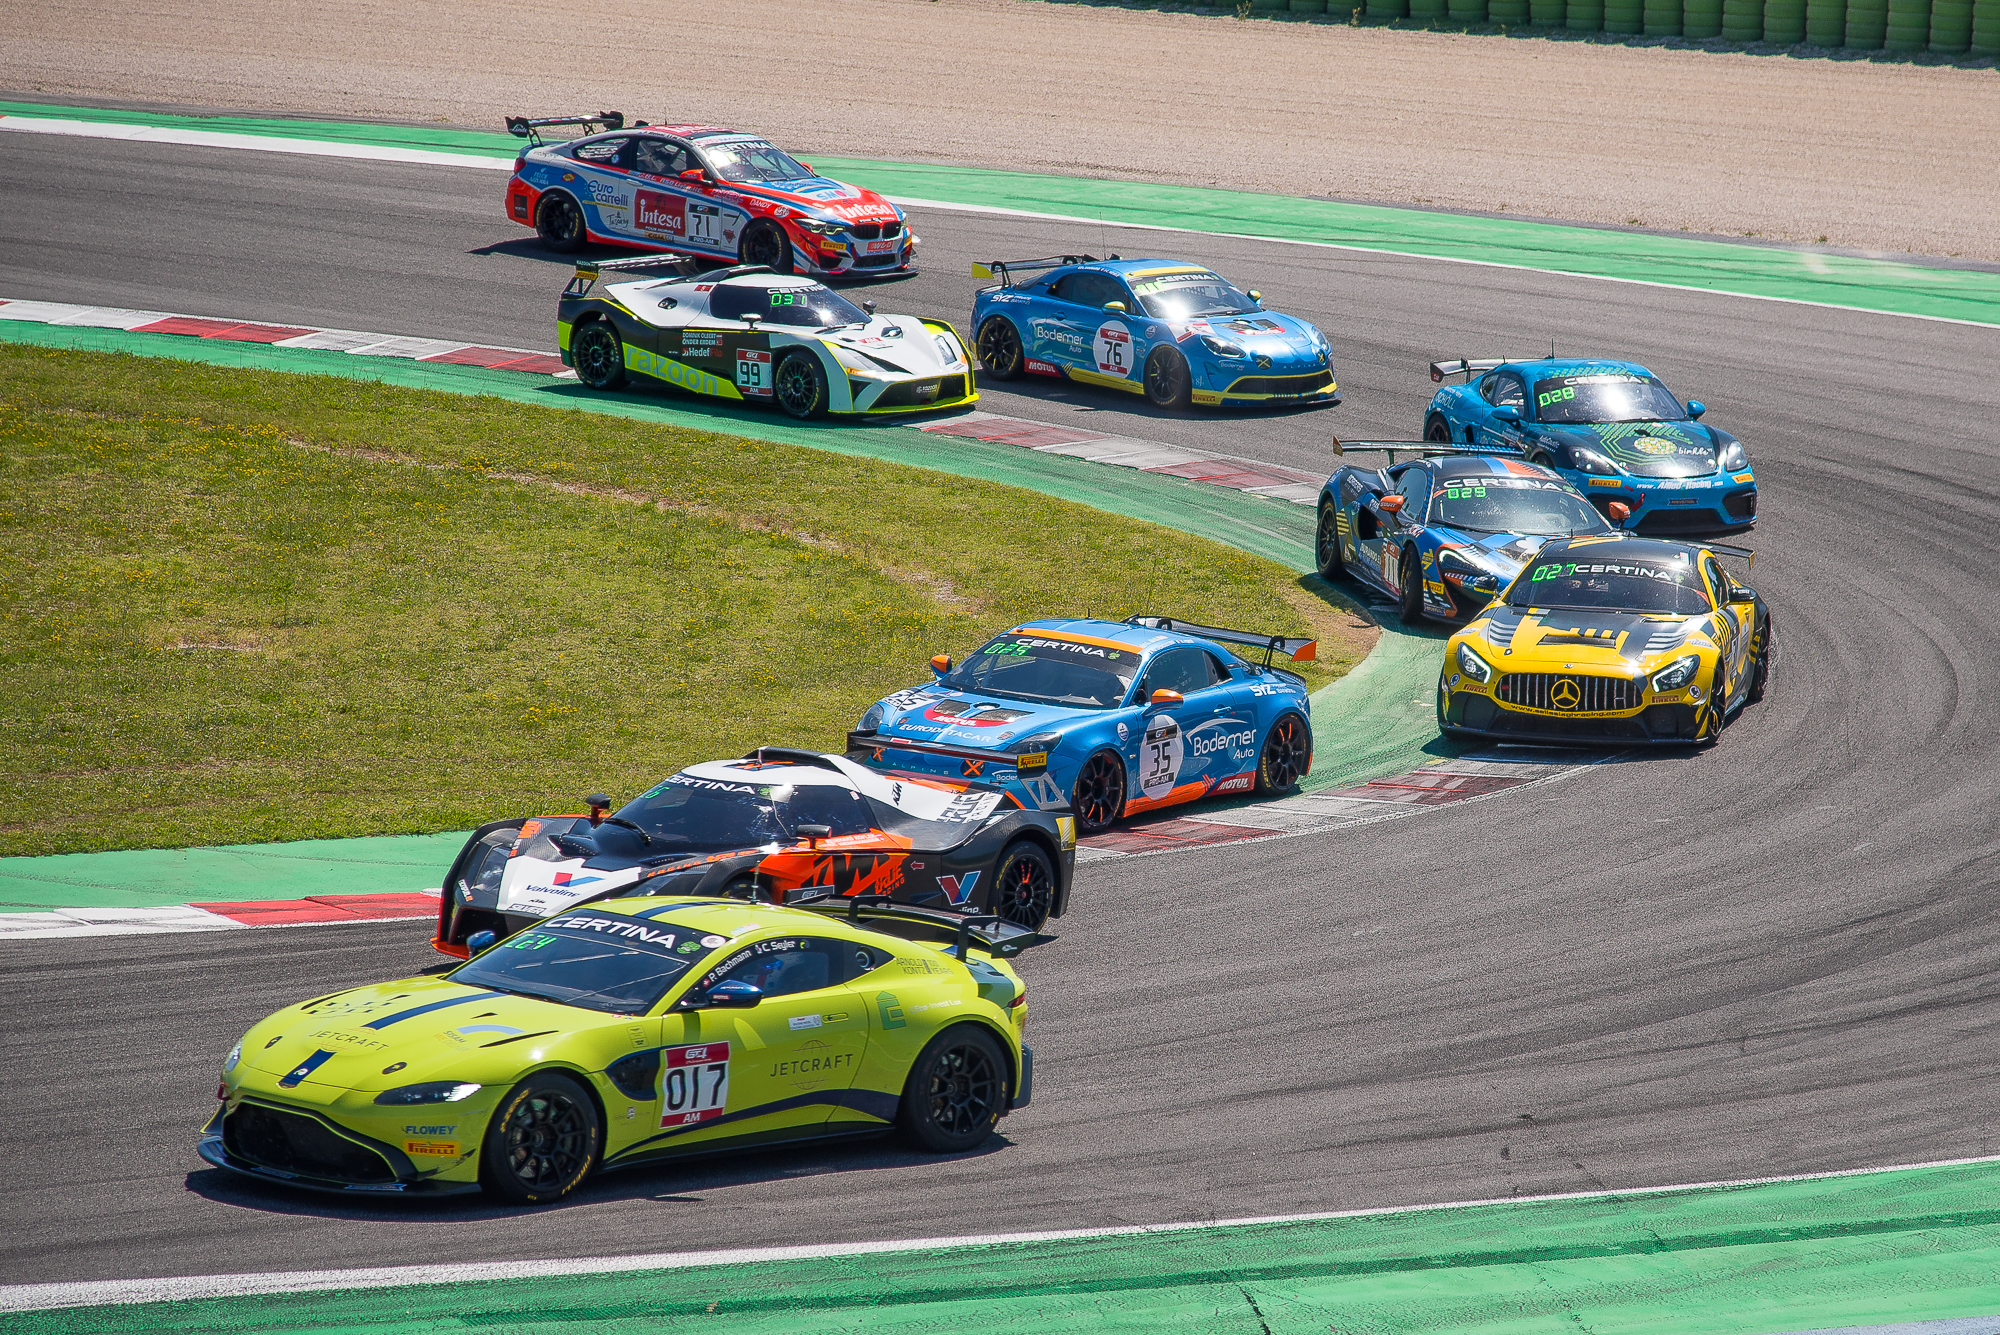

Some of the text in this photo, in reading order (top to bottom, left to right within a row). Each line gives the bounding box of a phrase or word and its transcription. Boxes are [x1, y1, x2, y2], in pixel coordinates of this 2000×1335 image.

[595, 192, 629, 207] carrelli
[749, 198, 772, 209] DANDY
[692, 214, 711, 237] 71
[1156, 274, 1214, 284] CERTINA
[1037, 326, 1084, 346] Bodemer
[1104, 341, 1122, 366] 76
[626, 345, 718, 396] razoon
[739, 361, 761, 386] 99
[1028, 361, 1056, 373] MOTUL
[1538, 386, 1575, 407] 028
[1442, 477, 1563, 492] CERTINA
[1590, 478, 1620, 488] PIRELLI
[1447, 486, 1487, 499] 029
[1531, 563, 1672, 582] 027 CERTINA
[1015, 638, 1106, 658] CERTINA
[1249, 682, 1277, 697] SYZ
[1463, 684, 1488, 694] PIRELLI
[1651, 695, 1680, 704] PIRELLI
[933, 715, 977, 727] MOTUL
[899, 723, 992, 743] EURODATACAR
[1193, 728, 1258, 757] Bodemer
[1149, 741, 1172, 777] 35
[1232, 748, 1255, 760] Auto
[892, 761, 950, 776] ALPINE
[1216, 776, 1249, 792] MOTUL
[525, 884, 581, 898] Valvoline
[511, 903, 547, 914] SILVER
[544, 916, 677, 950] CERTINA
[716, 949, 752, 977] Bachmann
[896, 957, 923, 967] ARNOLD
[902, 966, 927, 975] KONTZ
[308, 1030, 390, 1051] JETCRAFT
[769, 1053, 854, 1078] JETCRAFT
[666, 1063, 727, 1112] 017
[682, 1112, 701, 1124] AM
[405, 1125, 457, 1135] FLOWEY
[408, 1142, 454, 1156] PIRELLI
